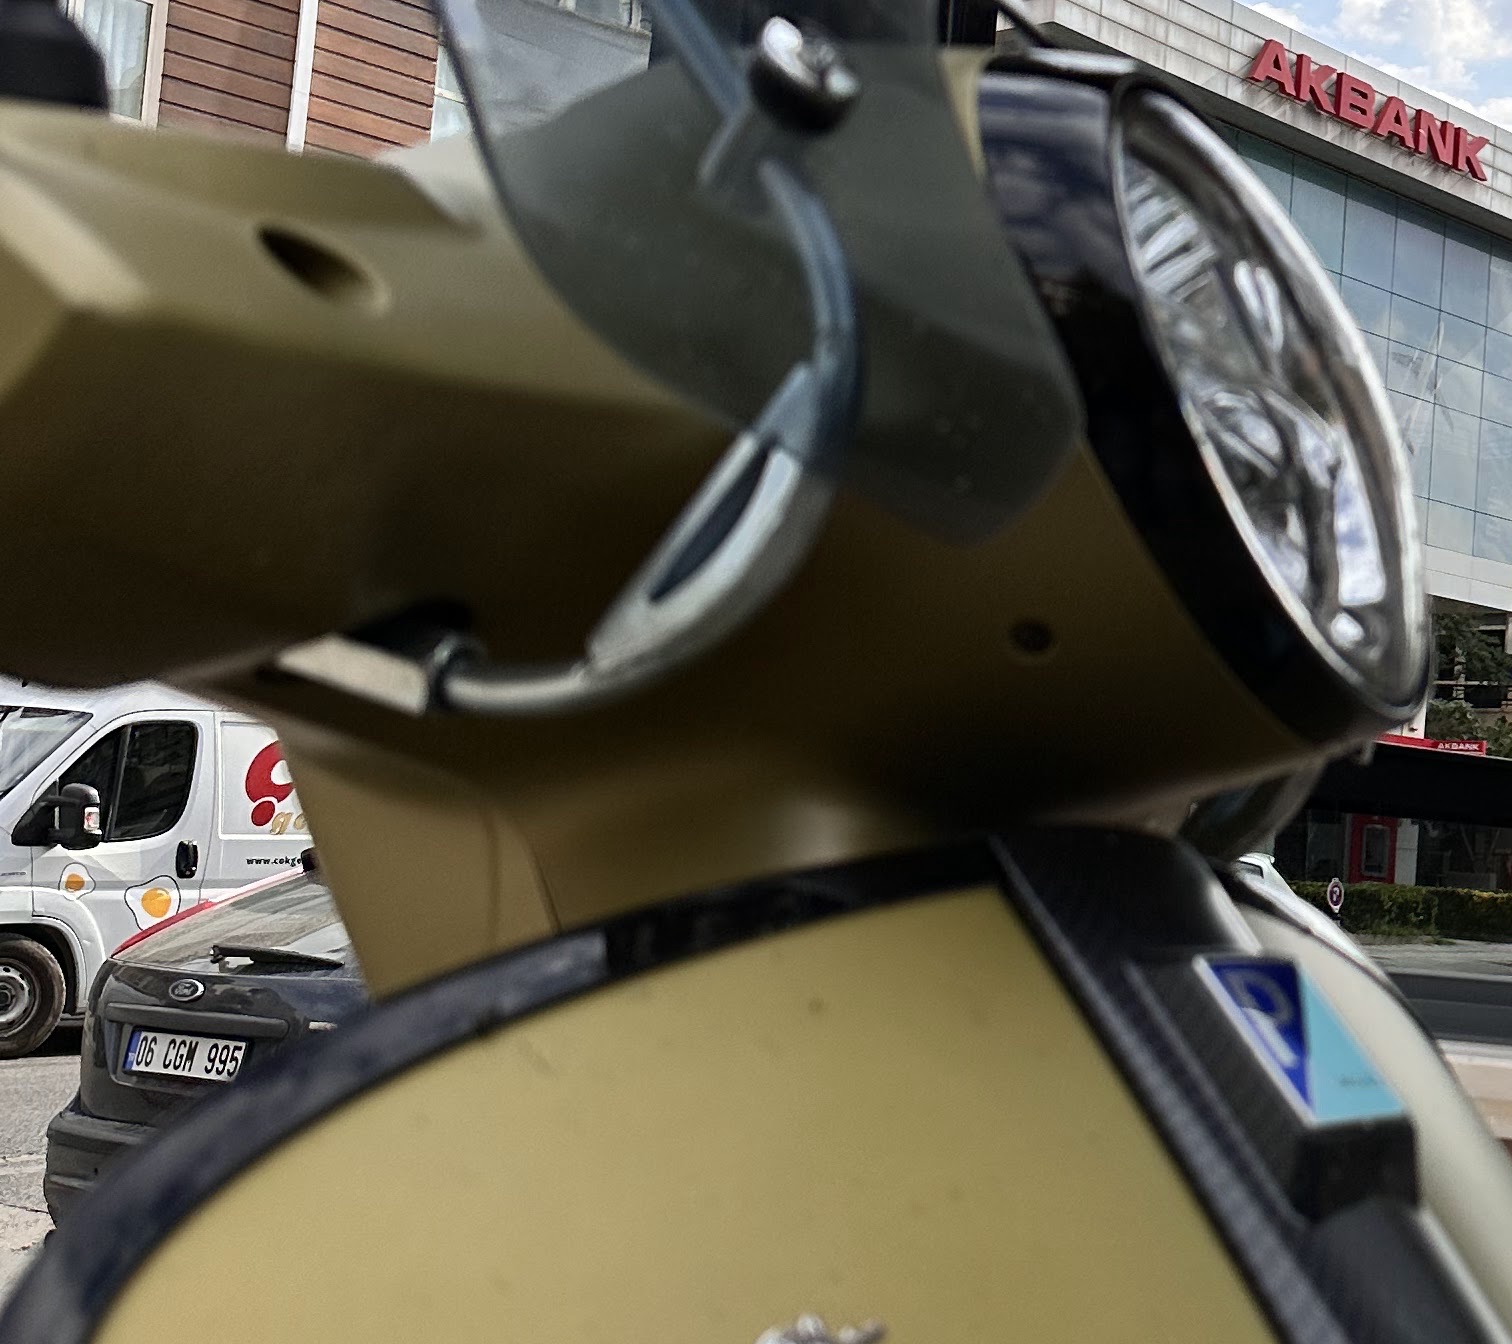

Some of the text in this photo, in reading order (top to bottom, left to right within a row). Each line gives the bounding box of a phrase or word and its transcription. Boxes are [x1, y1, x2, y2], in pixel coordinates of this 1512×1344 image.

[1248, 38, 1490, 182] AKBANK
[1436, 742, 1480, 751] AKBANK
[135, 1034, 243, 1078] 06 CGM 995
